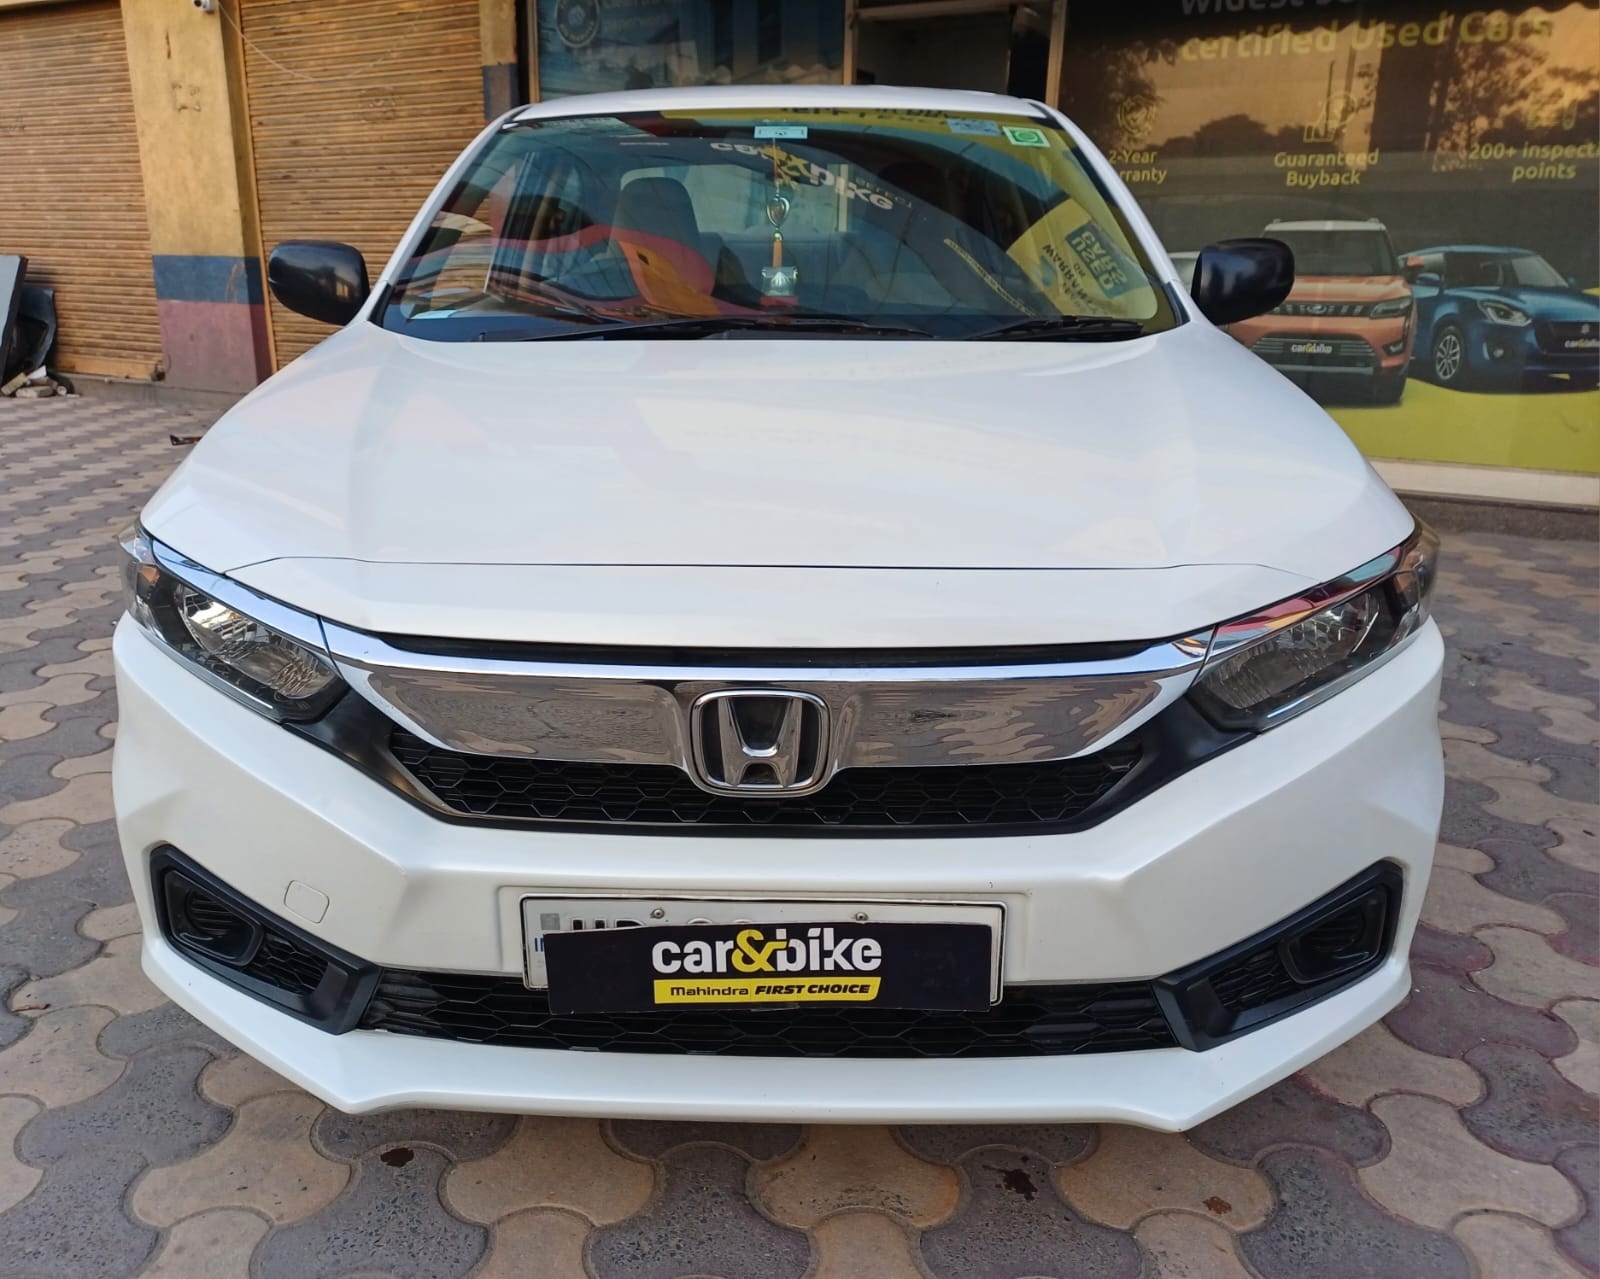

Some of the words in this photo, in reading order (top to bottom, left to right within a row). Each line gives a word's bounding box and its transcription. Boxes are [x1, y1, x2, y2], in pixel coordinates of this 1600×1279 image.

[1351, 11, 1447, 50] Used
[1458, 8, 1552, 44] Cars
[1108, 149, 1158, 165] 2-Year
[1274, 148, 1379, 169] Guaranteed
[1467, 142, 1518, 161] 200+
[1119, 167, 1168, 185] rranty
[1286, 169, 1361, 190] Buyback
[1511, 161, 1577, 183] points
[651, 927, 883, 974] car&bike
[670, 986, 749, 997] Mahindra
[755, 984, 805, 995] FIRST
[807, 984, 871, 994] CHOICE
